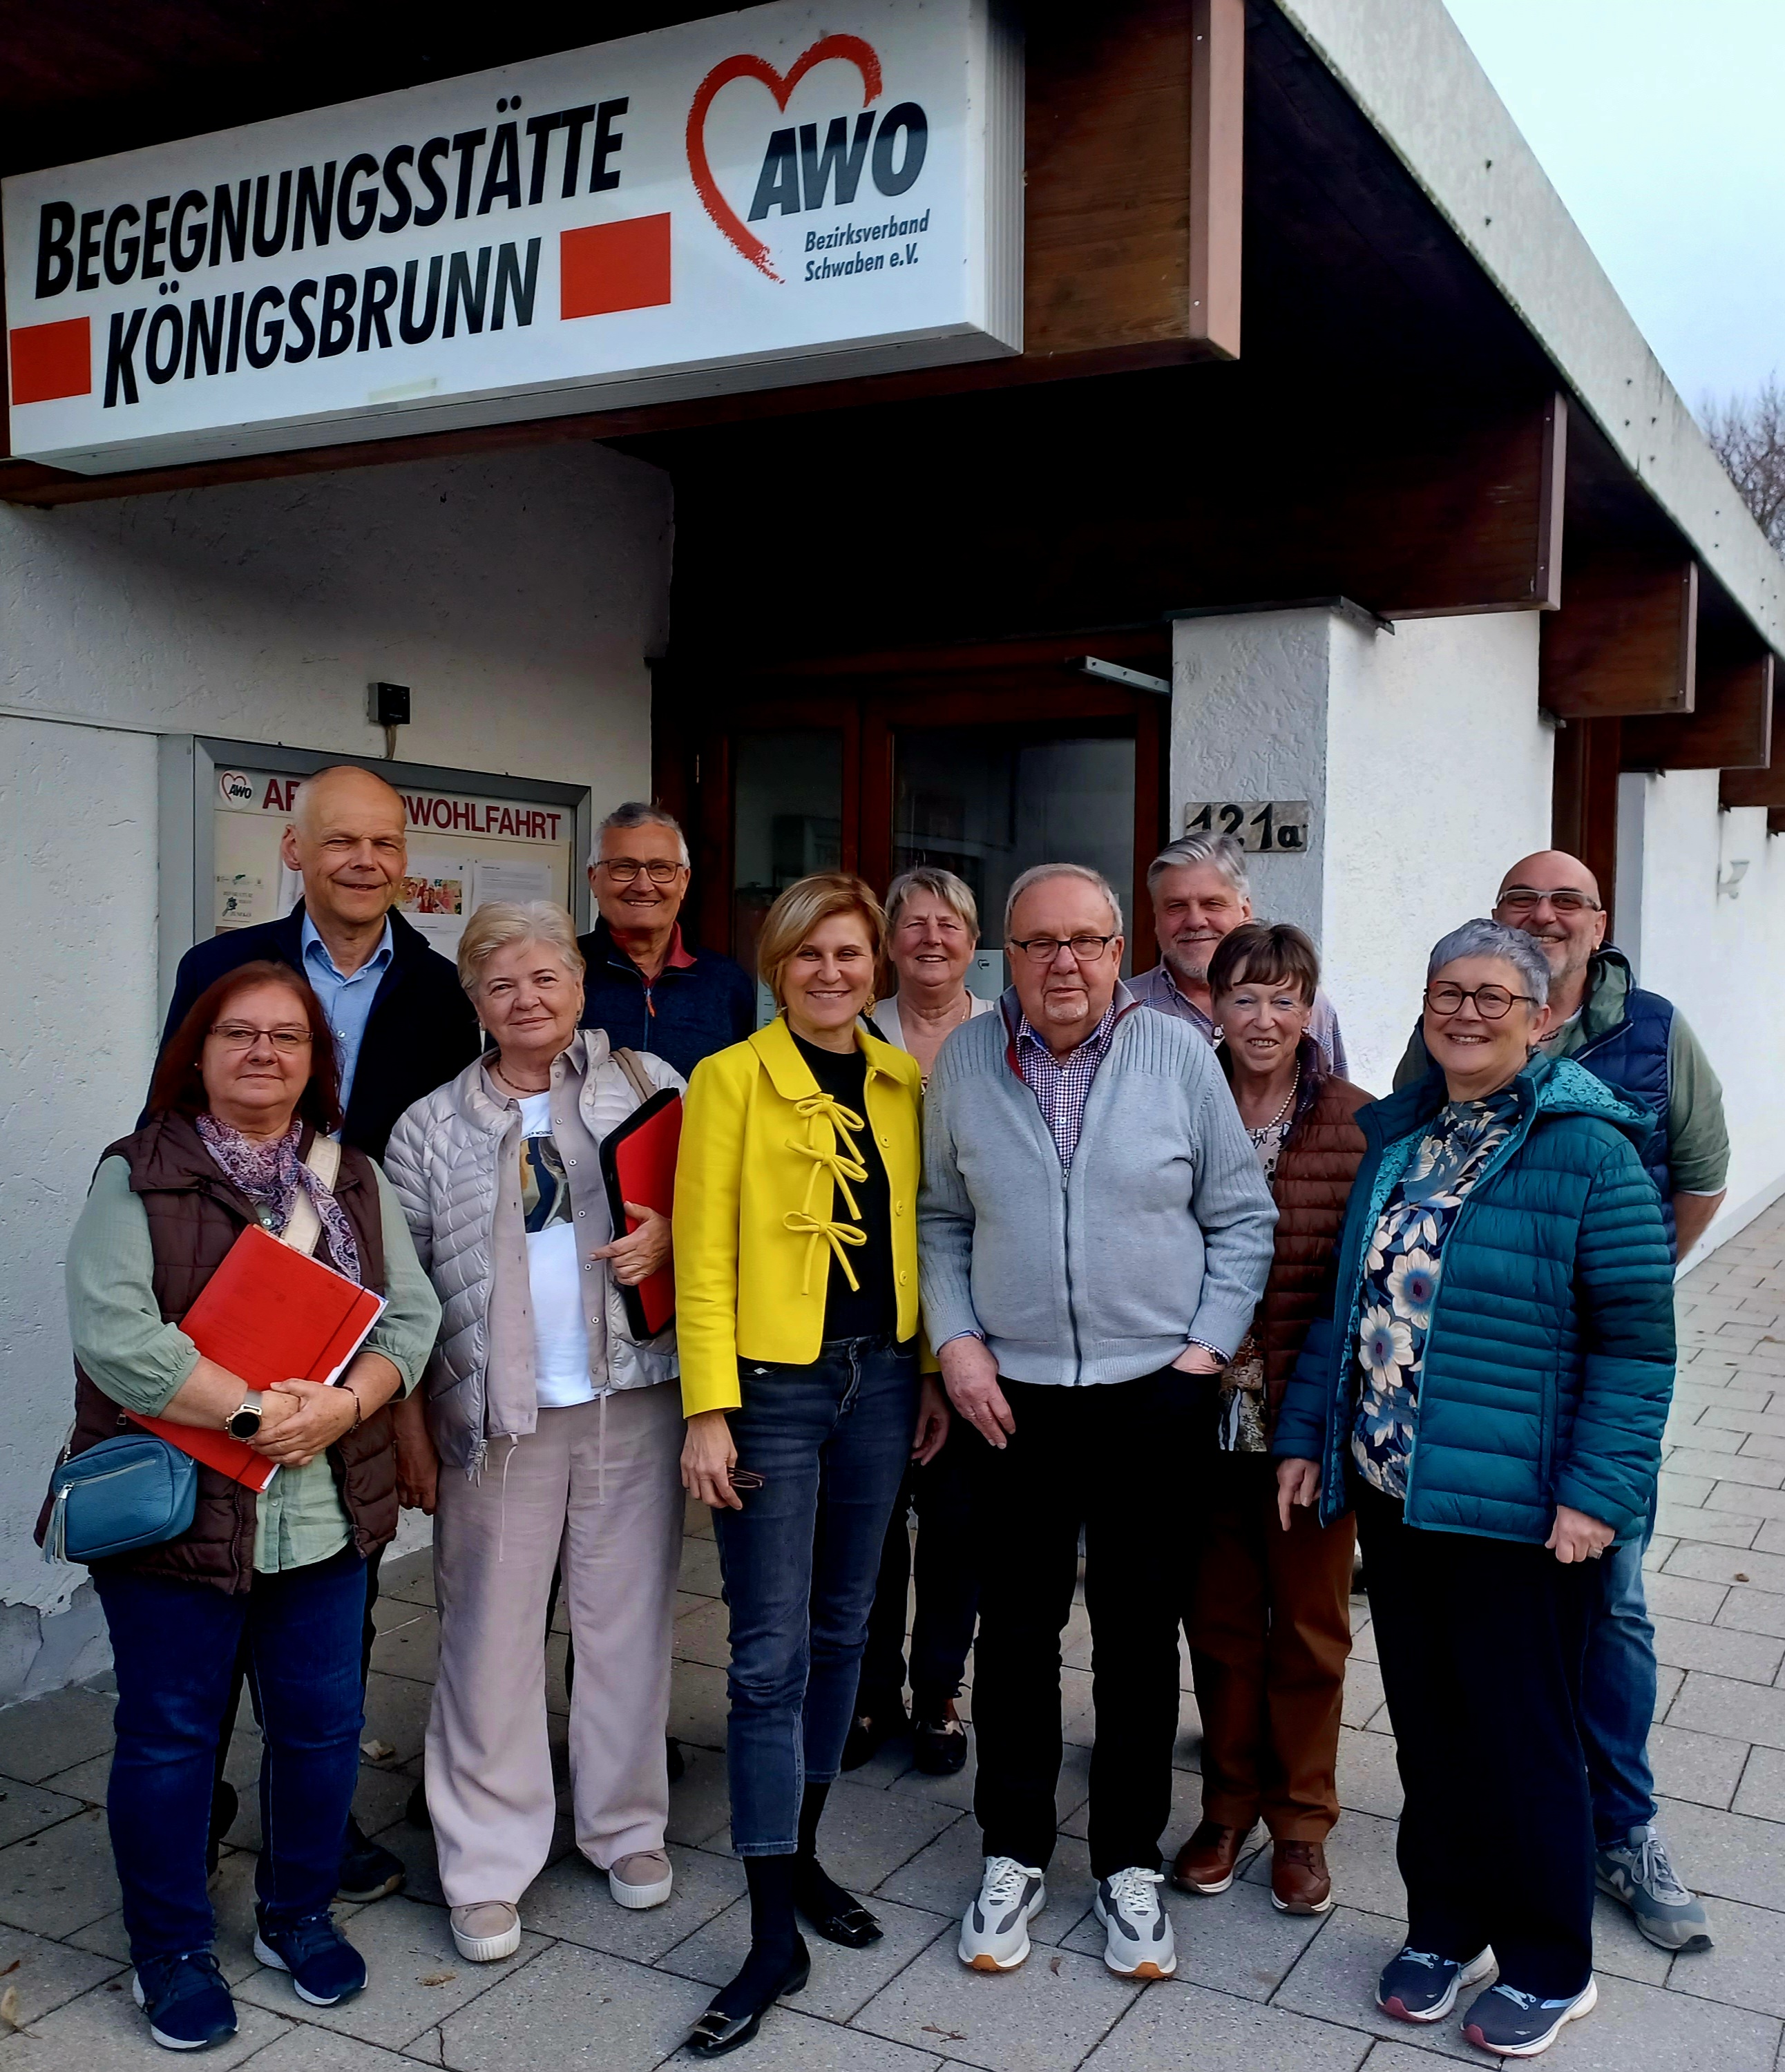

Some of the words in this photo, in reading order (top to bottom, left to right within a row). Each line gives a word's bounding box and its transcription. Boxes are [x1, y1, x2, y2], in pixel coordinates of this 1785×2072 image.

[747, 102, 928, 222] AWO
[35, 95, 630, 300] BEGEGNUNGSSTÄTTE
[804, 209, 931, 253] Bezirksverband
[804, 251, 885, 282] Schwaben
[889, 243, 919, 268] e.V.
[103, 238, 542, 409] KÖNIGSBRUNN
[228, 783, 253, 800] AWO
[1185, 803, 1304, 850] 121a
